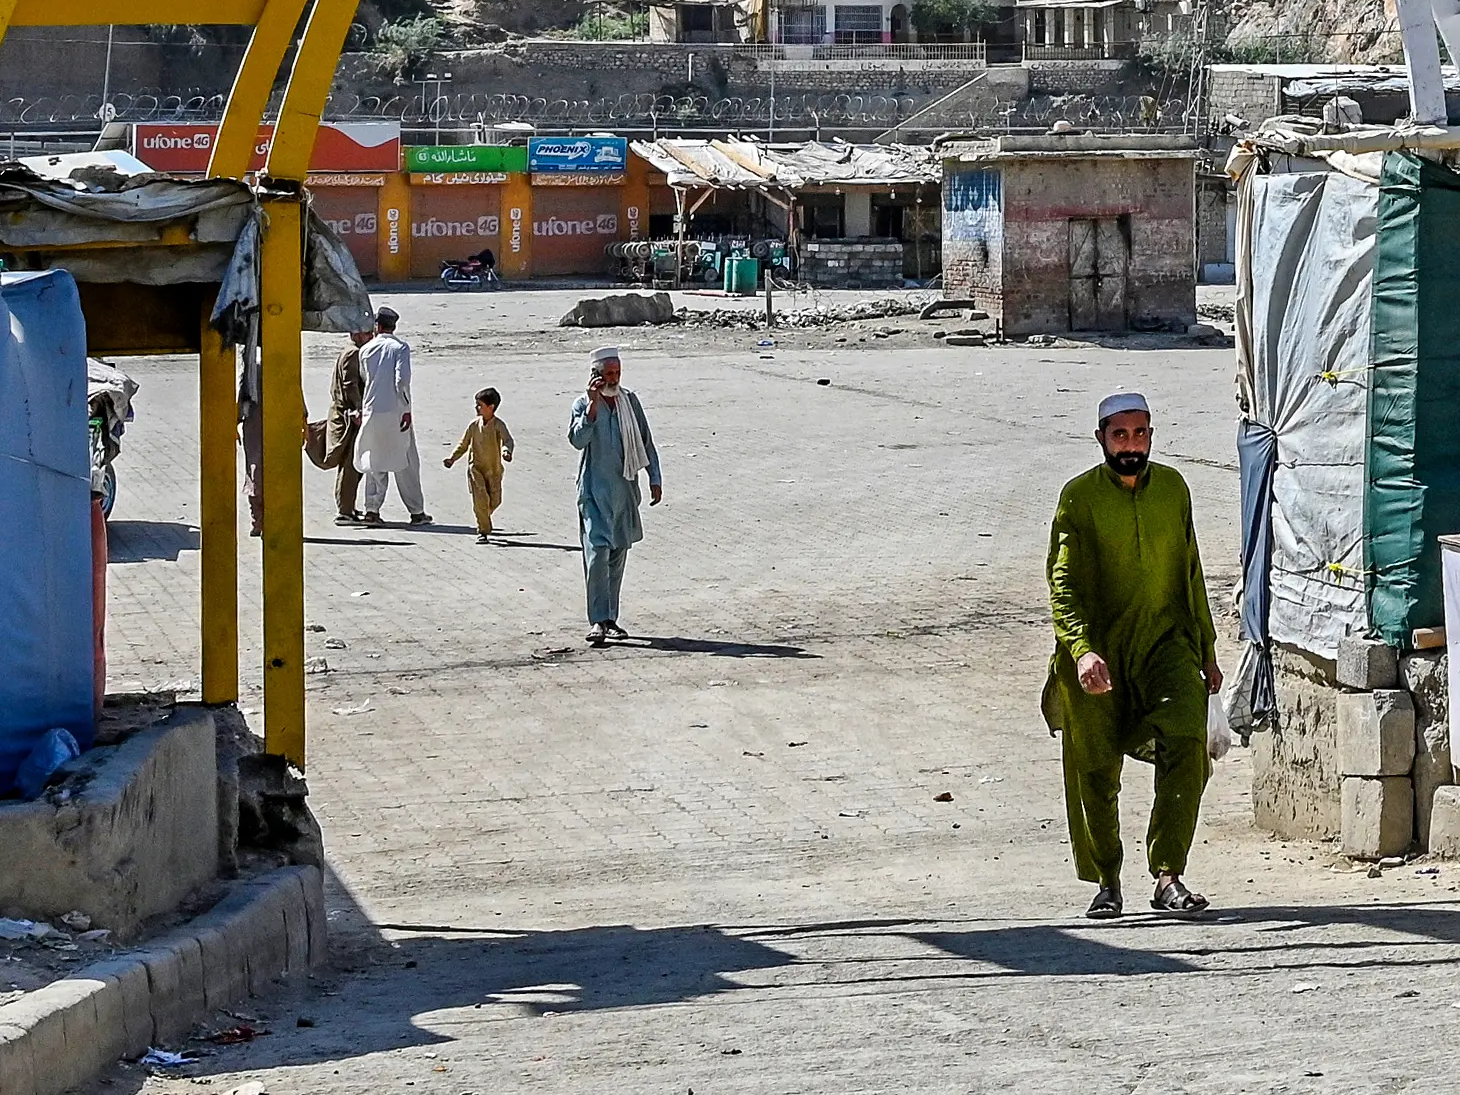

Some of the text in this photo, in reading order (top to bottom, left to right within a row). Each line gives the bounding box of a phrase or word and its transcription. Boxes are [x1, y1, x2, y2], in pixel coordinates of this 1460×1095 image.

[143, 133, 210, 149] ufone 4G
[536, 144, 589, 155] PHOENIX
[356, 214, 377, 233] 4G
[411, 216, 499, 237] ufone 4G
[533, 214, 617, 236] ufone 4G
[629, 219, 640, 243] one
[389, 221, 399, 254] ufone
[510, 220, 521, 253] ufone
